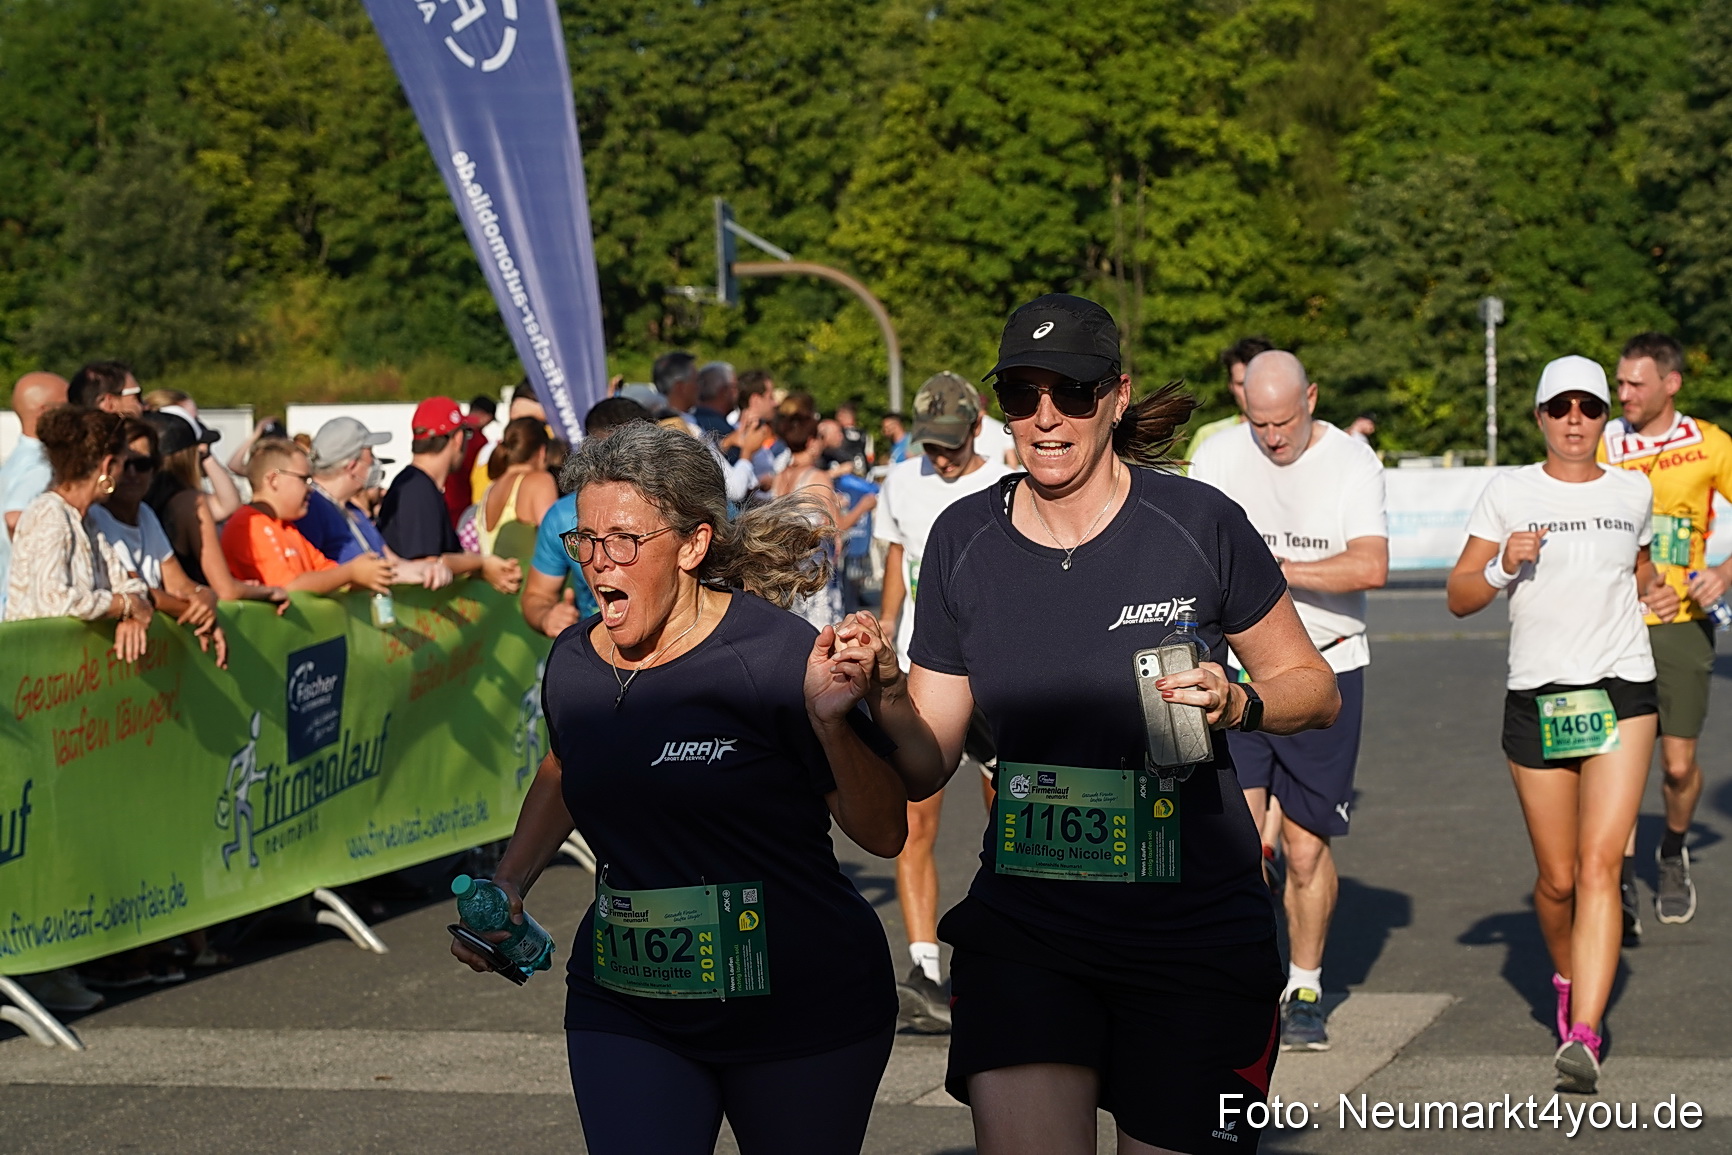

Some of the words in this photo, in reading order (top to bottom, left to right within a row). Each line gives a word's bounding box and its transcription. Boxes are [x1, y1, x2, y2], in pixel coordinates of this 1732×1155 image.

[1659, 450, 1708, 471] BÖGL
[1594, 517, 1635, 532] Team
[1284, 532, 1329, 549] Team
[1108, 602, 1172, 631] JURA
[14, 646, 101, 722] Gesunde
[53, 706, 110, 768] laufen
[1551, 712, 1603, 737] 1460
[651, 741, 714, 767] JURA
[264, 711, 392, 830] firmenlauf
[1031, 786, 1070, 795] Firmenlauf
[1004, 813, 1017, 852] RUN
[1020, 802, 1109, 845] 1163
[1014, 842, 1065, 861] Weißflog
[1069, 847, 1112, 860] Nicole
[1112, 815, 1128, 866] 2022
[609, 909, 649, 918] Firmenlauf
[723, 897, 731, 913] AOK
[596, 929, 606, 967] RUN
[604, 923, 695, 963] 1162
[698, 931, 716, 983] 2022
[610, 960, 640, 977] Gradl
[642, 965, 692, 981] Brigitte
[1211, 1129, 1239, 1143] erima
